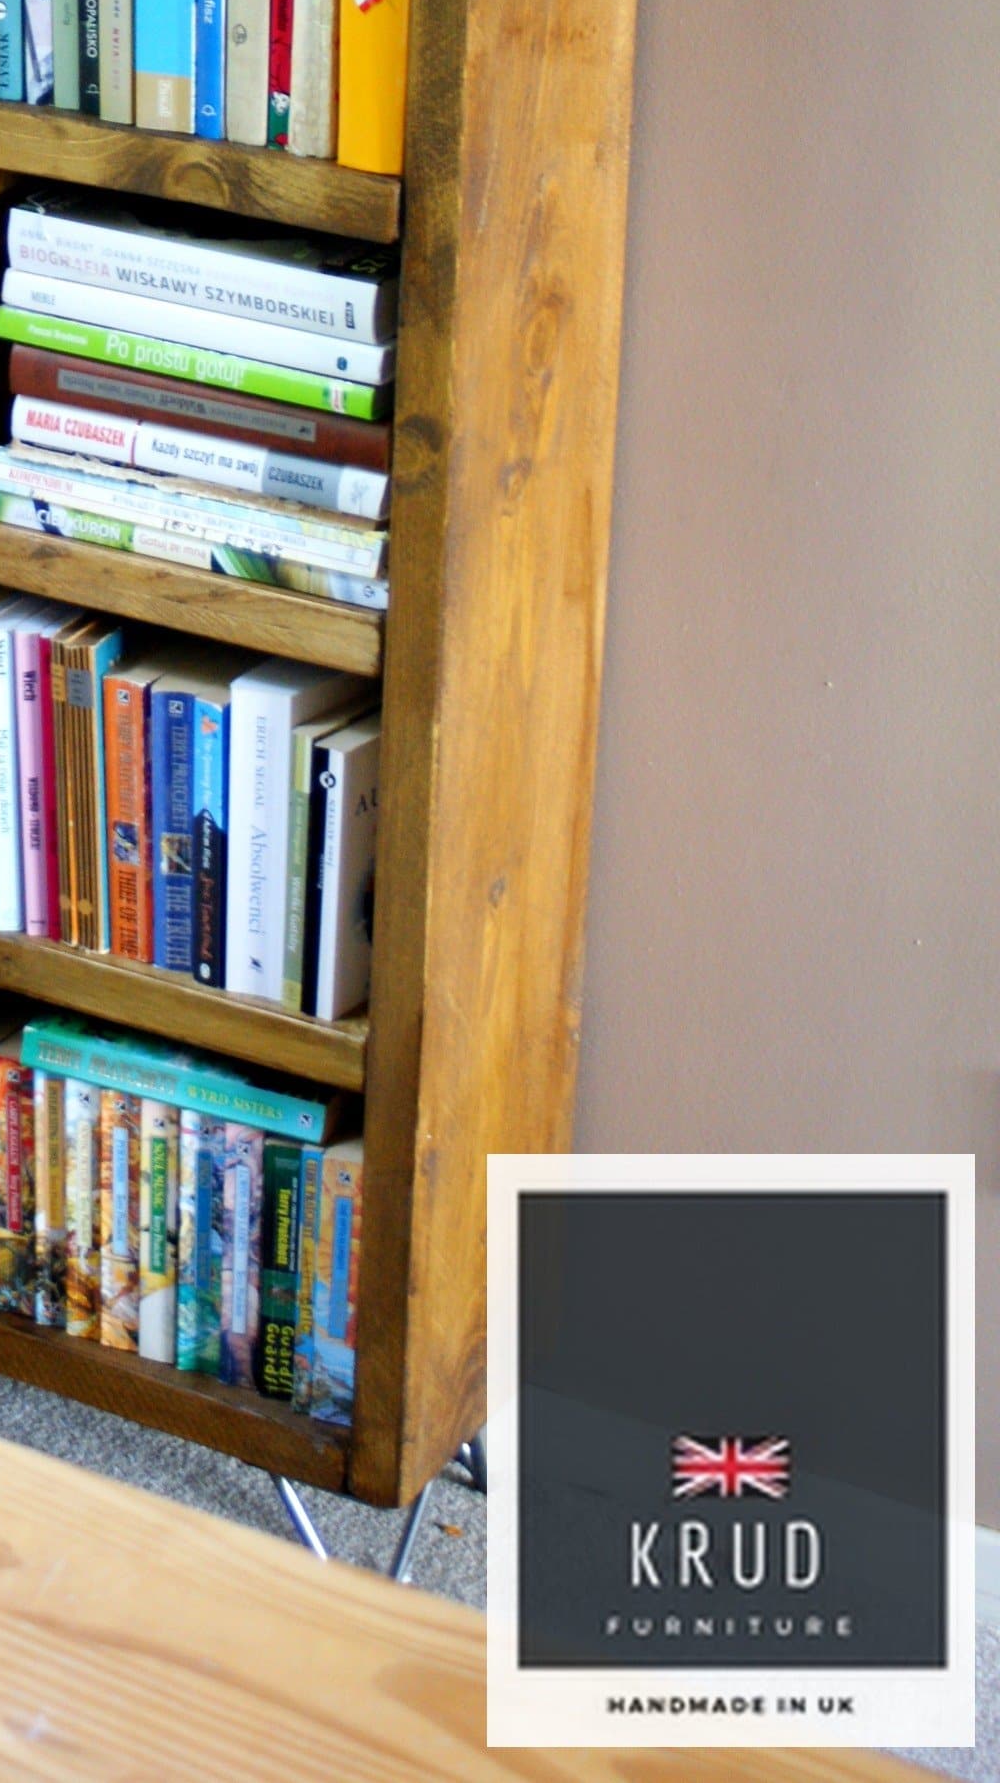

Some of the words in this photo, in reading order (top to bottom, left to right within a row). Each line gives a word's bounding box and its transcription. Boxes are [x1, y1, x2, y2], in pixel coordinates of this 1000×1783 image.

[116, 267, 198, 297] WISŁAWY
[205, 285, 335, 327] SZYMBORSKIEJ
[105, 334, 129, 358] Po
[135, 342, 189, 375] prostu
[26, 410, 62, 434] MARIA
[62, 414, 126, 449] CZUBASZEK
[267, 466, 323, 491] CZUBASZEK
[24, 670, 38, 701] Wiech
[170, 725, 189, 762] TERRY
[170, 766, 189, 829] PRATCHETT
[254, 766, 265, 809] SEGAL
[118, 870, 137, 905] THIEF
[166, 885, 192, 914] THE
[247, 826, 269, 936] Absolwenci
[119, 908, 138, 923] OF
[120, 926, 139, 955] TIME
[166, 916, 192, 965] TRUTH
[277, 1188, 290, 1215] Terry
[276, 1217, 290, 1266] Pratchett
